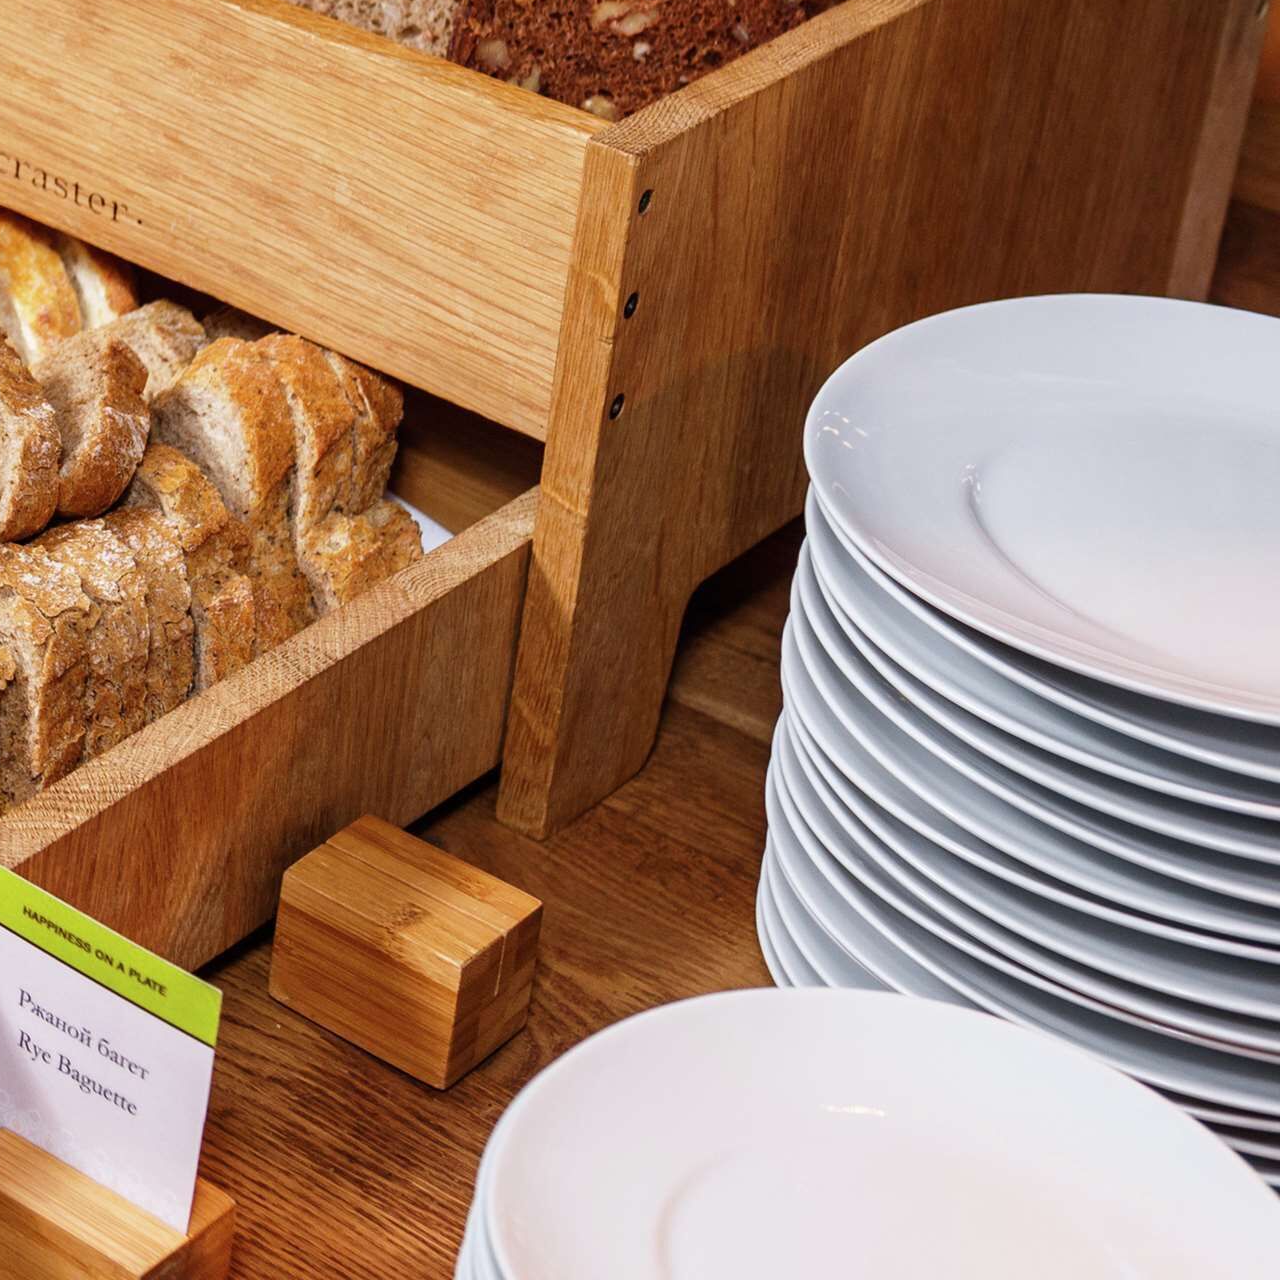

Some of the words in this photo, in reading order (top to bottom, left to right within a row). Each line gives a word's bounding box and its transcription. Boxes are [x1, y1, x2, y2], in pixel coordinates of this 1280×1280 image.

[22, 904, 91, 954] HAPPINESS
[95, 948, 114, 968] ON
[116, 961, 127, 975] A
[129, 967, 168, 997] PLATE
[18, 988, 92, 1050] Ржаной
[97, 1036, 150, 1083] багет
[18, 1029, 51, 1067] Rye
[57, 1053, 139, 1117] Baguette
